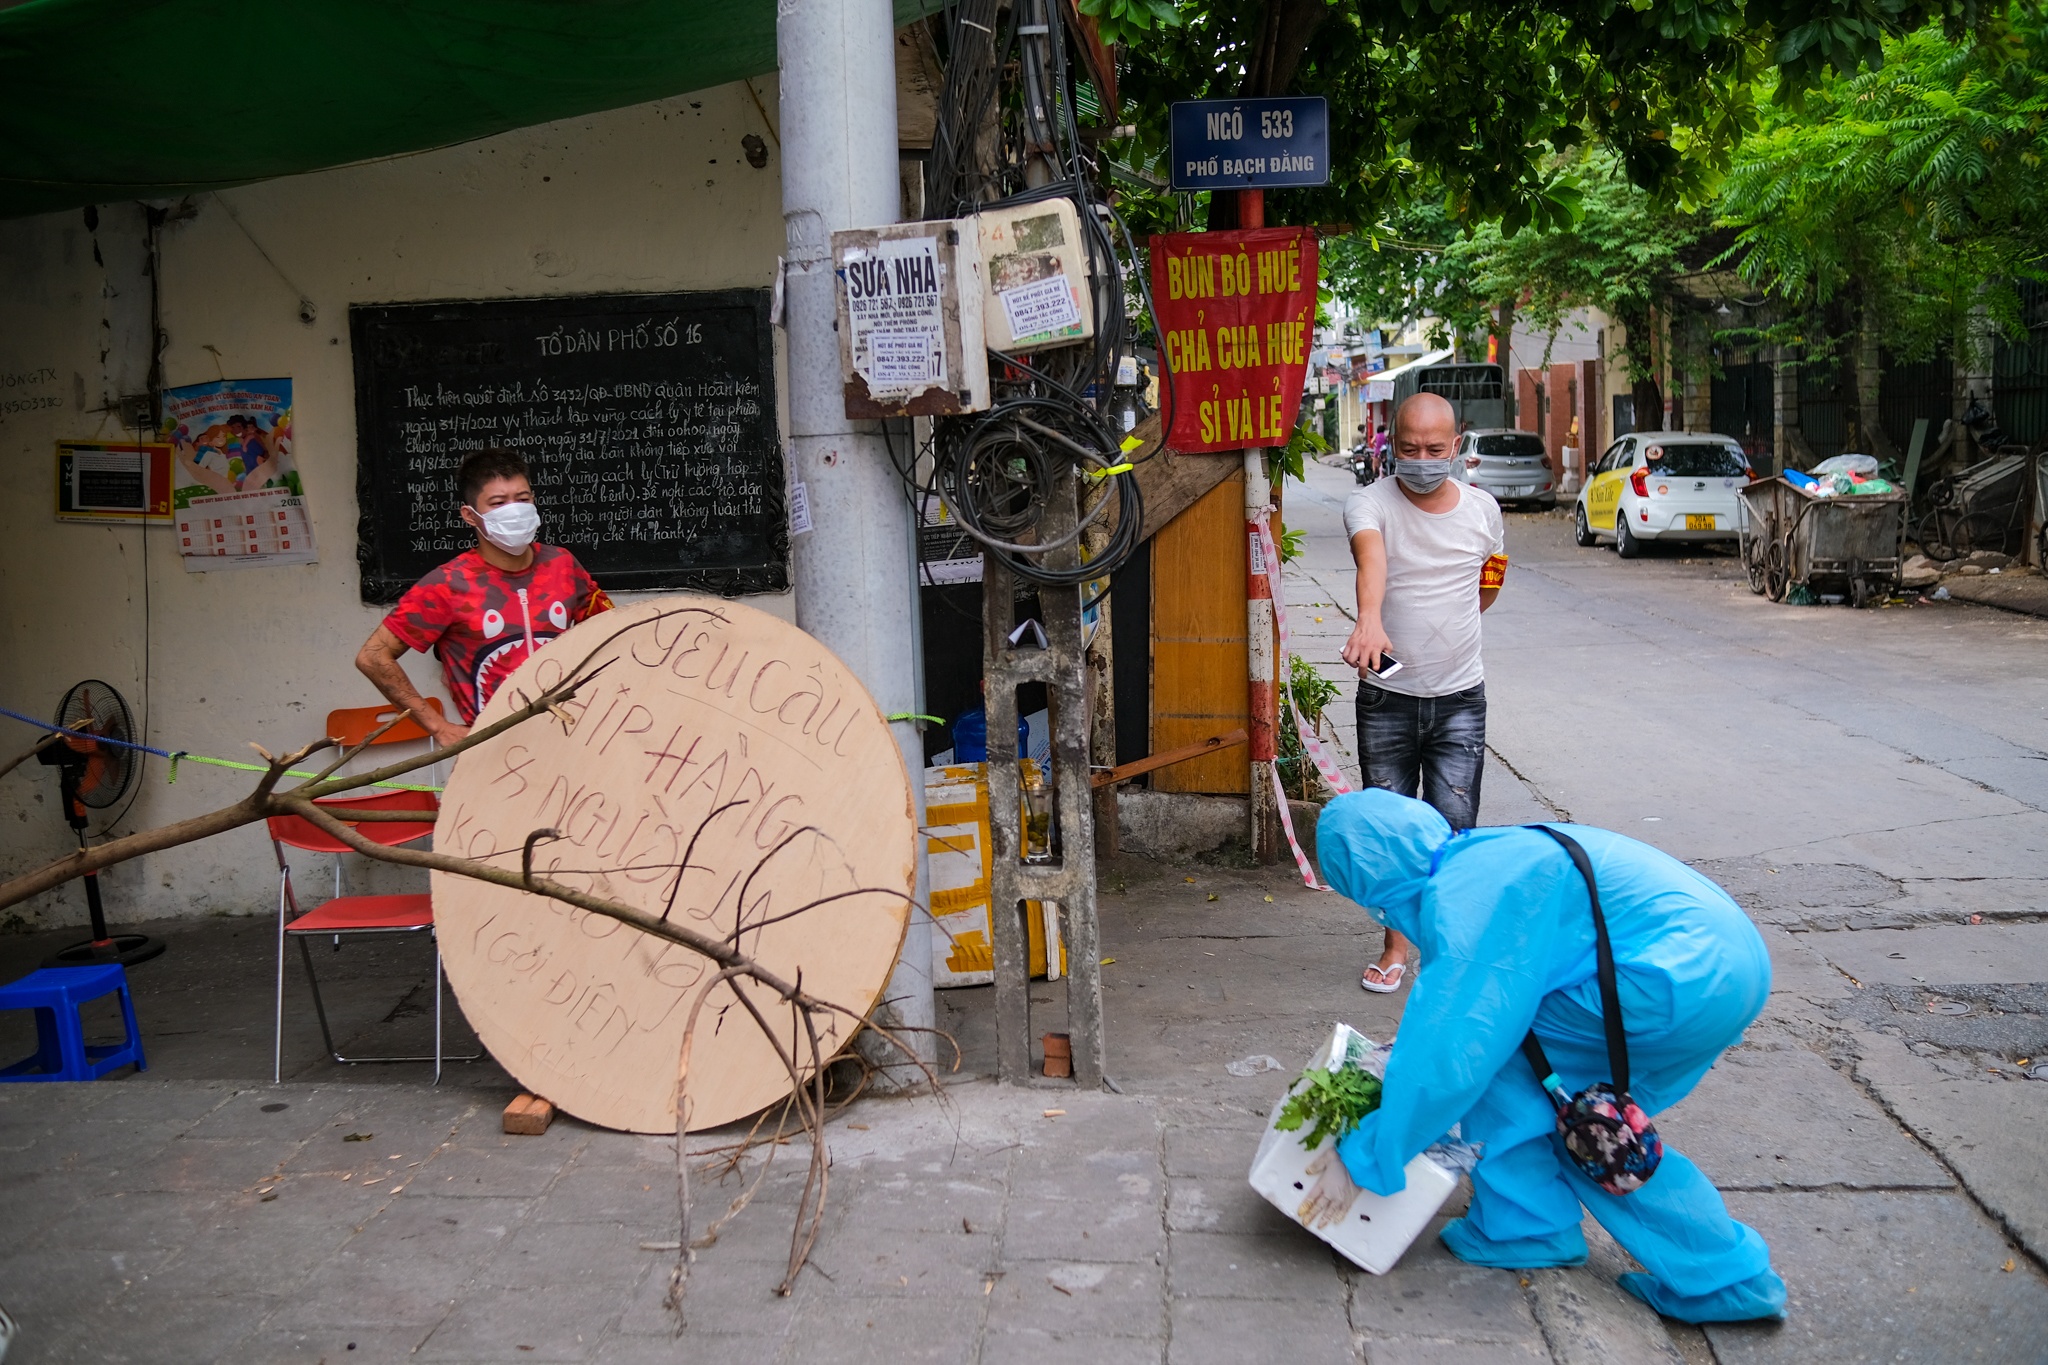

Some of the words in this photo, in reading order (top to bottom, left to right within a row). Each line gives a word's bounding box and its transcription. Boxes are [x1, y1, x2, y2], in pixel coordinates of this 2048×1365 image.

[1207, 106, 1243, 140] NGÕ
[1261, 110, 1293, 139] 533
[1186, 155, 1219, 177] PHỐ
[1223, 158, 1266, 178] BẠCH
[1270, 149, 1314, 173] ĐẰNG
[895, 247, 937, 294] NHÀ
[1168, 247, 1215, 300] BÚN
[1220, 243, 1251, 297] BÒ
[1257, 234, 1302, 294] HUẾ
[852, 300, 867, 312] 0926
[898, 297, 913, 309] 0926
[914, 296, 925, 308] 721
[926, 295, 938, 307] 567
[1014, 298, 1066, 318] 0847.393.222
[535, 325, 564, 356] TỔ
[564, 328, 600, 353] DÂN
[608, 317, 652, 352] PHỐ
[654, 316, 680, 347] SỐ
[686, 323, 702, 345] 16
[1166, 310, 1212, 374] CHẢ
[1217, 325, 1261, 370] CUA
[1267, 306, 1308, 366] HUẾ
[404, 385, 434, 411] Thực
[437, 382, 461, 408] hiện
[497, 381, 525, 406] định
[529, 378, 549, 402] số
[1199, 384, 1222, 444] SỈ
[1226, 389, 1254, 442] VÀ
[1259, 376, 1282, 438] LẺ
[440, 413, 498, 434] 31/7/2021
[523, 408, 562, 428] thành
[568, 406, 590, 426] lập
[593, 408, 628, 430] vùng
[630, 400, 664, 420] cách
[694, 399, 709, 418] tế
[540, 447, 572, 474] trong
[575, 447, 596, 465] địa
[600, 440, 624, 460] bàn
[668, 440, 691, 460] tiếp
[718, 438, 737, 453] với
[548, 430, 577, 454] ngày
[579, 428, 639, 447] 31/7/2021
[408, 476, 439, 500] người
[537, 468, 563, 486] khỏi
[568, 470, 599, 494] vùng
[602, 462, 634, 482] cách
[727, 456, 750, 479] hợp
[281, 498, 302, 507] 2021
[412, 494, 438, 518] phải
[562, 486, 596, 504] chữa
[688, 480, 713, 497] các
[738, 478, 763, 497] dân
[409, 514, 441, 536] chấp
[570, 506, 594, 526] hợp
[637, 504, 664, 520] dân
[712, 500, 741, 516] tuân
[742, 496, 762, 514] thủ
[410, 536, 431, 552] yêu
[434, 534, 455, 550] cầu
[458, 533, 480, 549] các
[602, 523, 628, 541] chế
[630, 522, 648, 542] thi
